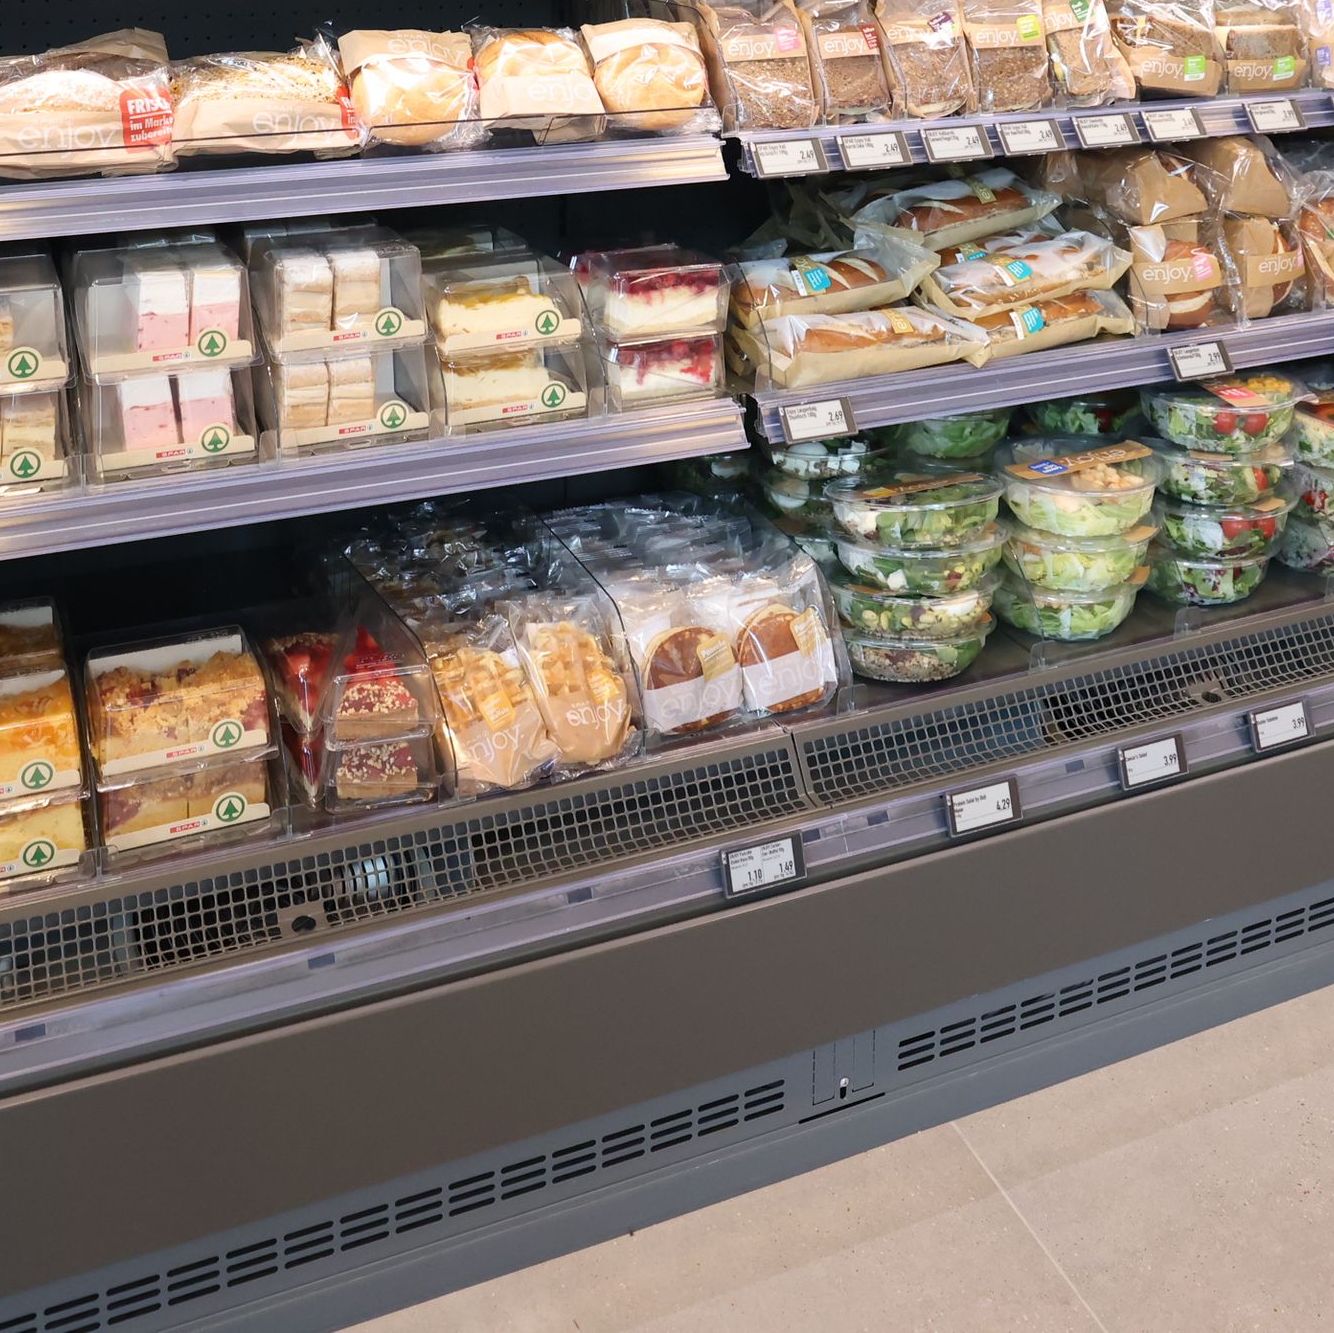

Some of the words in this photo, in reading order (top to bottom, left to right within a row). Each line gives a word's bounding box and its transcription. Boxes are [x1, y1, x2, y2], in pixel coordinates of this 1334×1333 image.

[528, 77, 595, 106] enjo
[1142, 262, 1195, 285] enjoy.
[828, 410, 843, 421] 2.69
[1292, 717, 1305, 729] 3.99
[1163, 754, 1177, 766] 3.99
[996, 798, 1010, 810] 4.29
[779, 860, 793, 873] 1.49
[748, 869, 762, 881] 1.10
